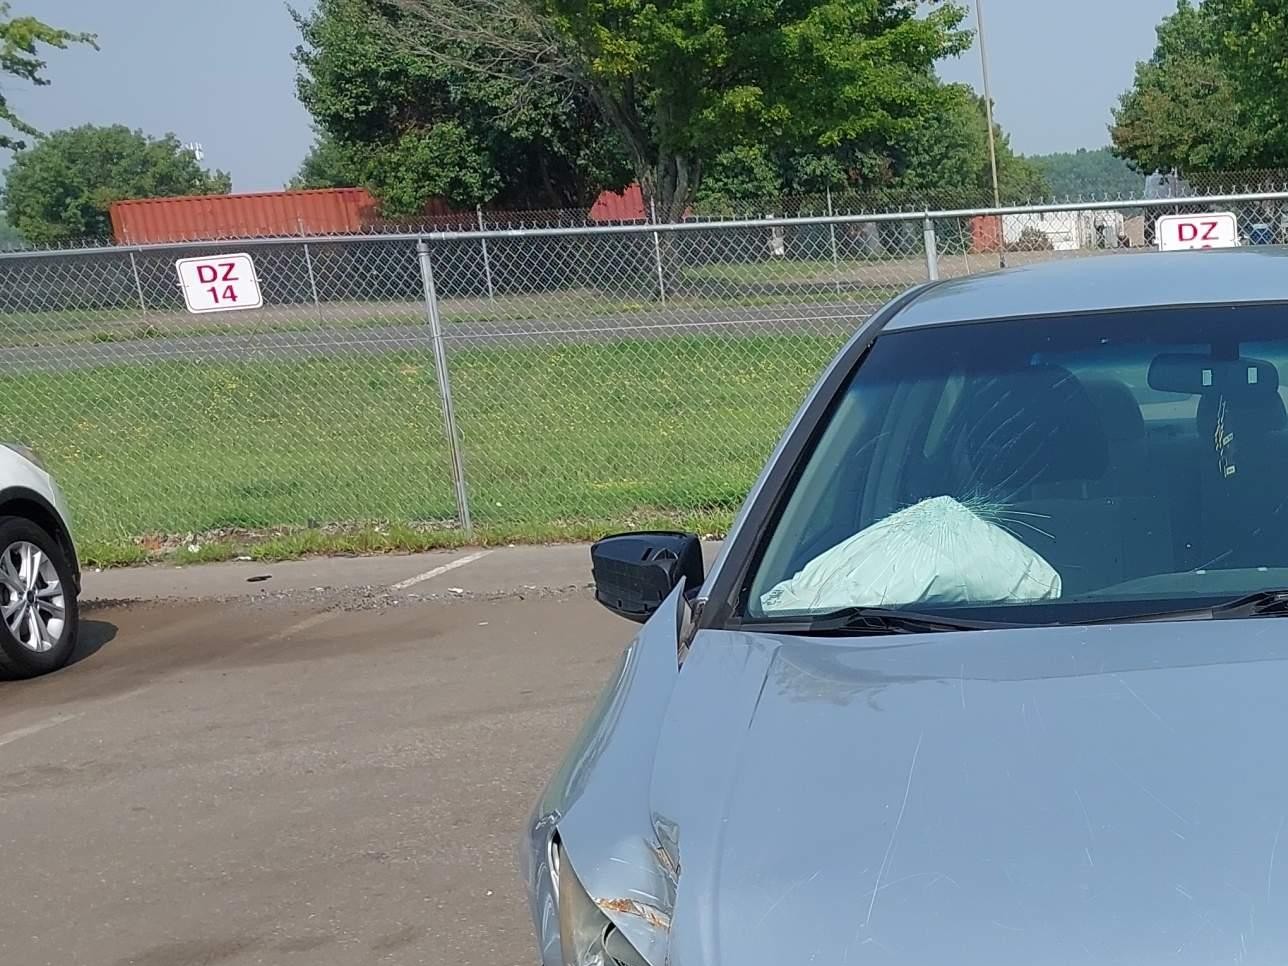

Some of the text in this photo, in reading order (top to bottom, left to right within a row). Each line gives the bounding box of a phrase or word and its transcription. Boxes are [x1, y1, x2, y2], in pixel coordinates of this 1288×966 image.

[1177, 221, 1219, 242] DZ
[196, 262, 239, 284] DZ
[206, 284, 239, 304] 14
